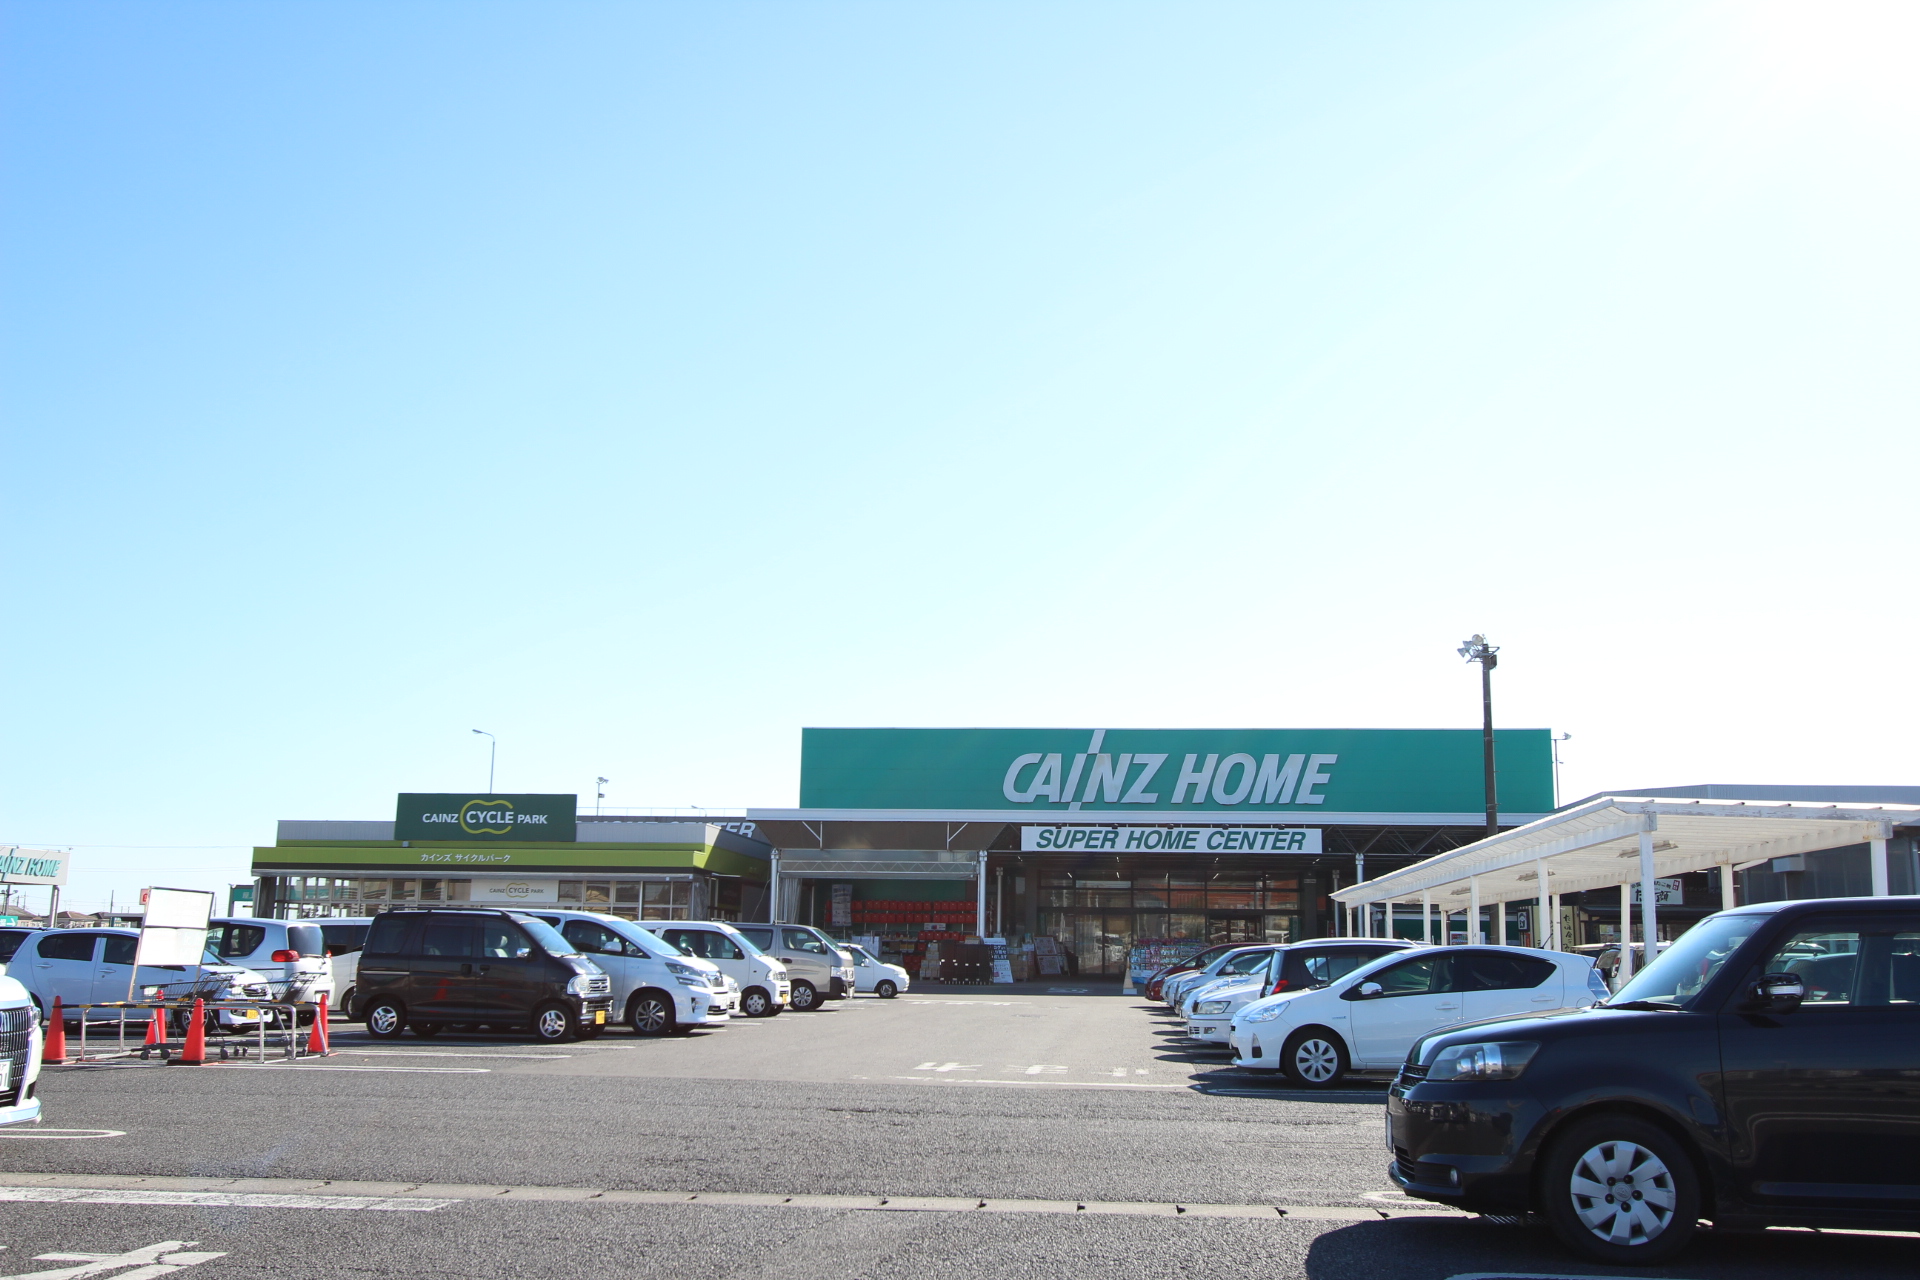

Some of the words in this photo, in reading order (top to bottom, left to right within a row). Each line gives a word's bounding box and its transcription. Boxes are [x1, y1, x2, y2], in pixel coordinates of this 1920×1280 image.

[1003, 730, 1169, 811] CAINZ
[1171, 752, 1338, 806] HOME
[422, 813, 459, 823] CAINZ
[466, 811, 514, 824] CYCLE
[517, 814, 548, 824] PARK
[1036, 830, 1119, 849] SUPER
[1125, 831, 1200, 850] HOME
[1206, 831, 1307, 851] CENTER
[25, 857, 62, 877] HOME
[420, 853, 452, 862] カインズ
[455, 854, 511, 863] サイクルパーク
